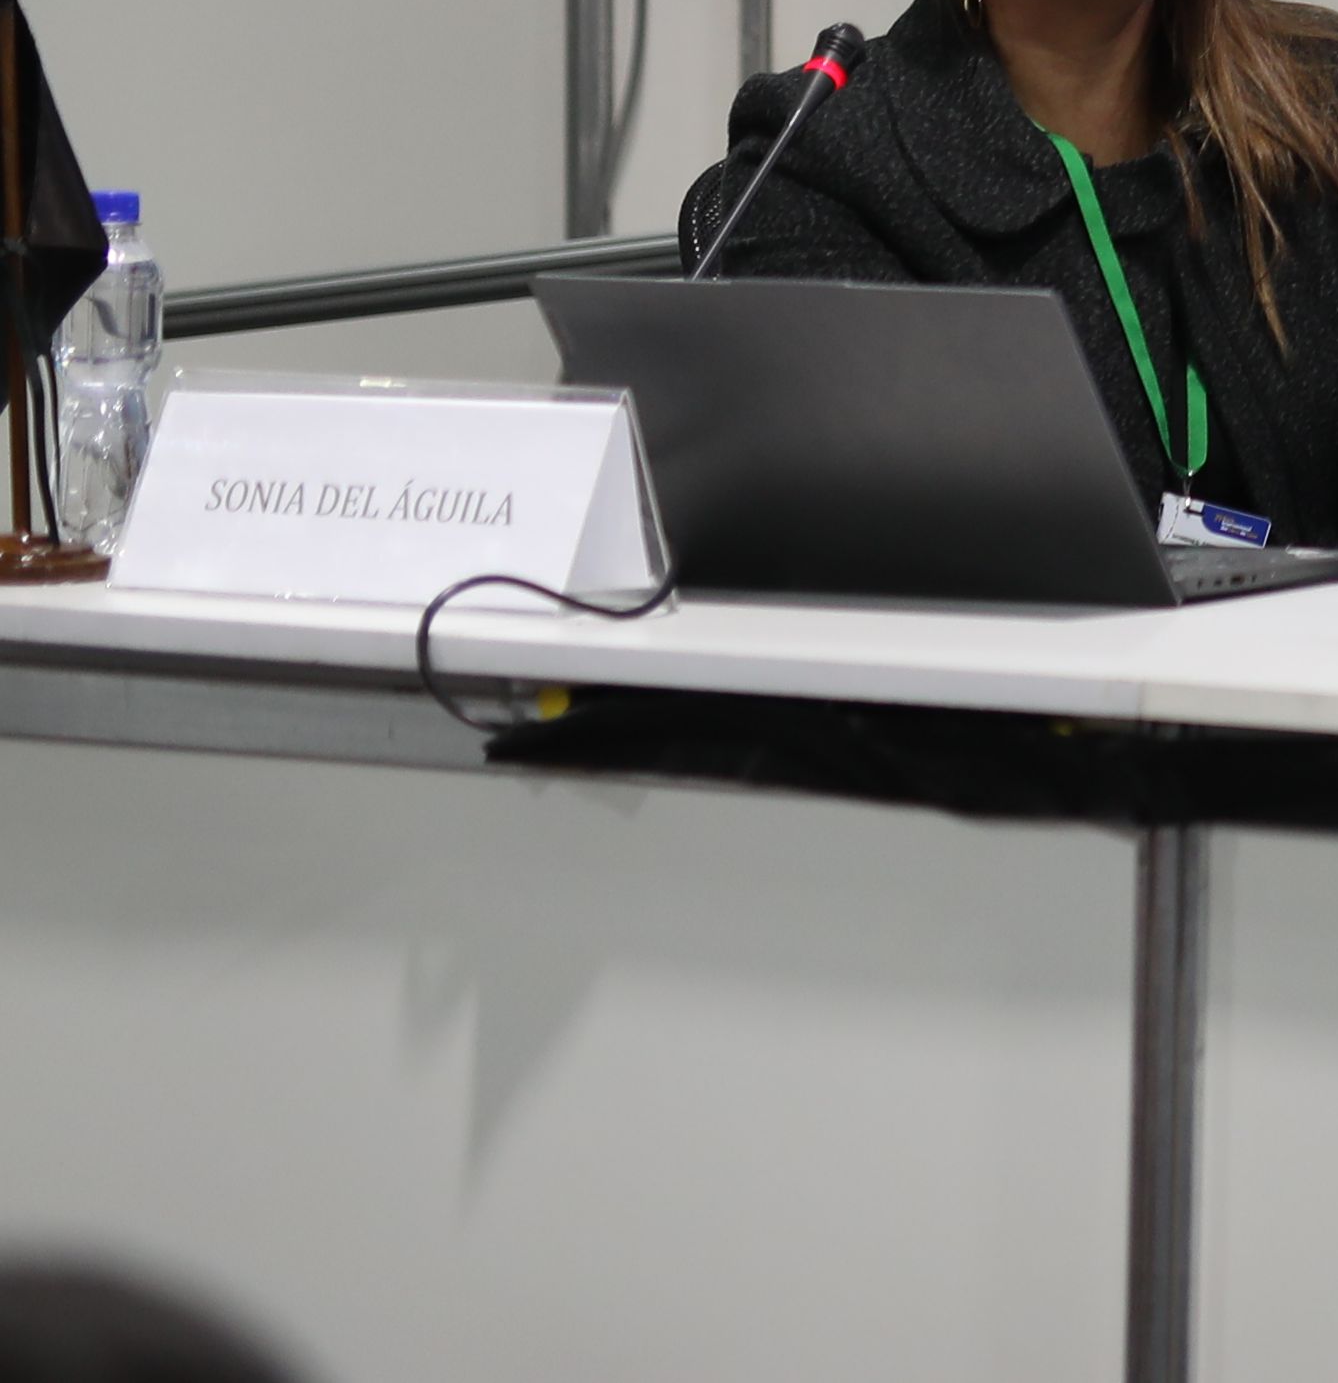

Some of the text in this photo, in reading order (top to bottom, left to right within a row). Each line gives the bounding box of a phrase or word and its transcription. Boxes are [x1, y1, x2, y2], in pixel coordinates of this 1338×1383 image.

[205, 478, 514, 526] SONIA DEL ÁGUILA
